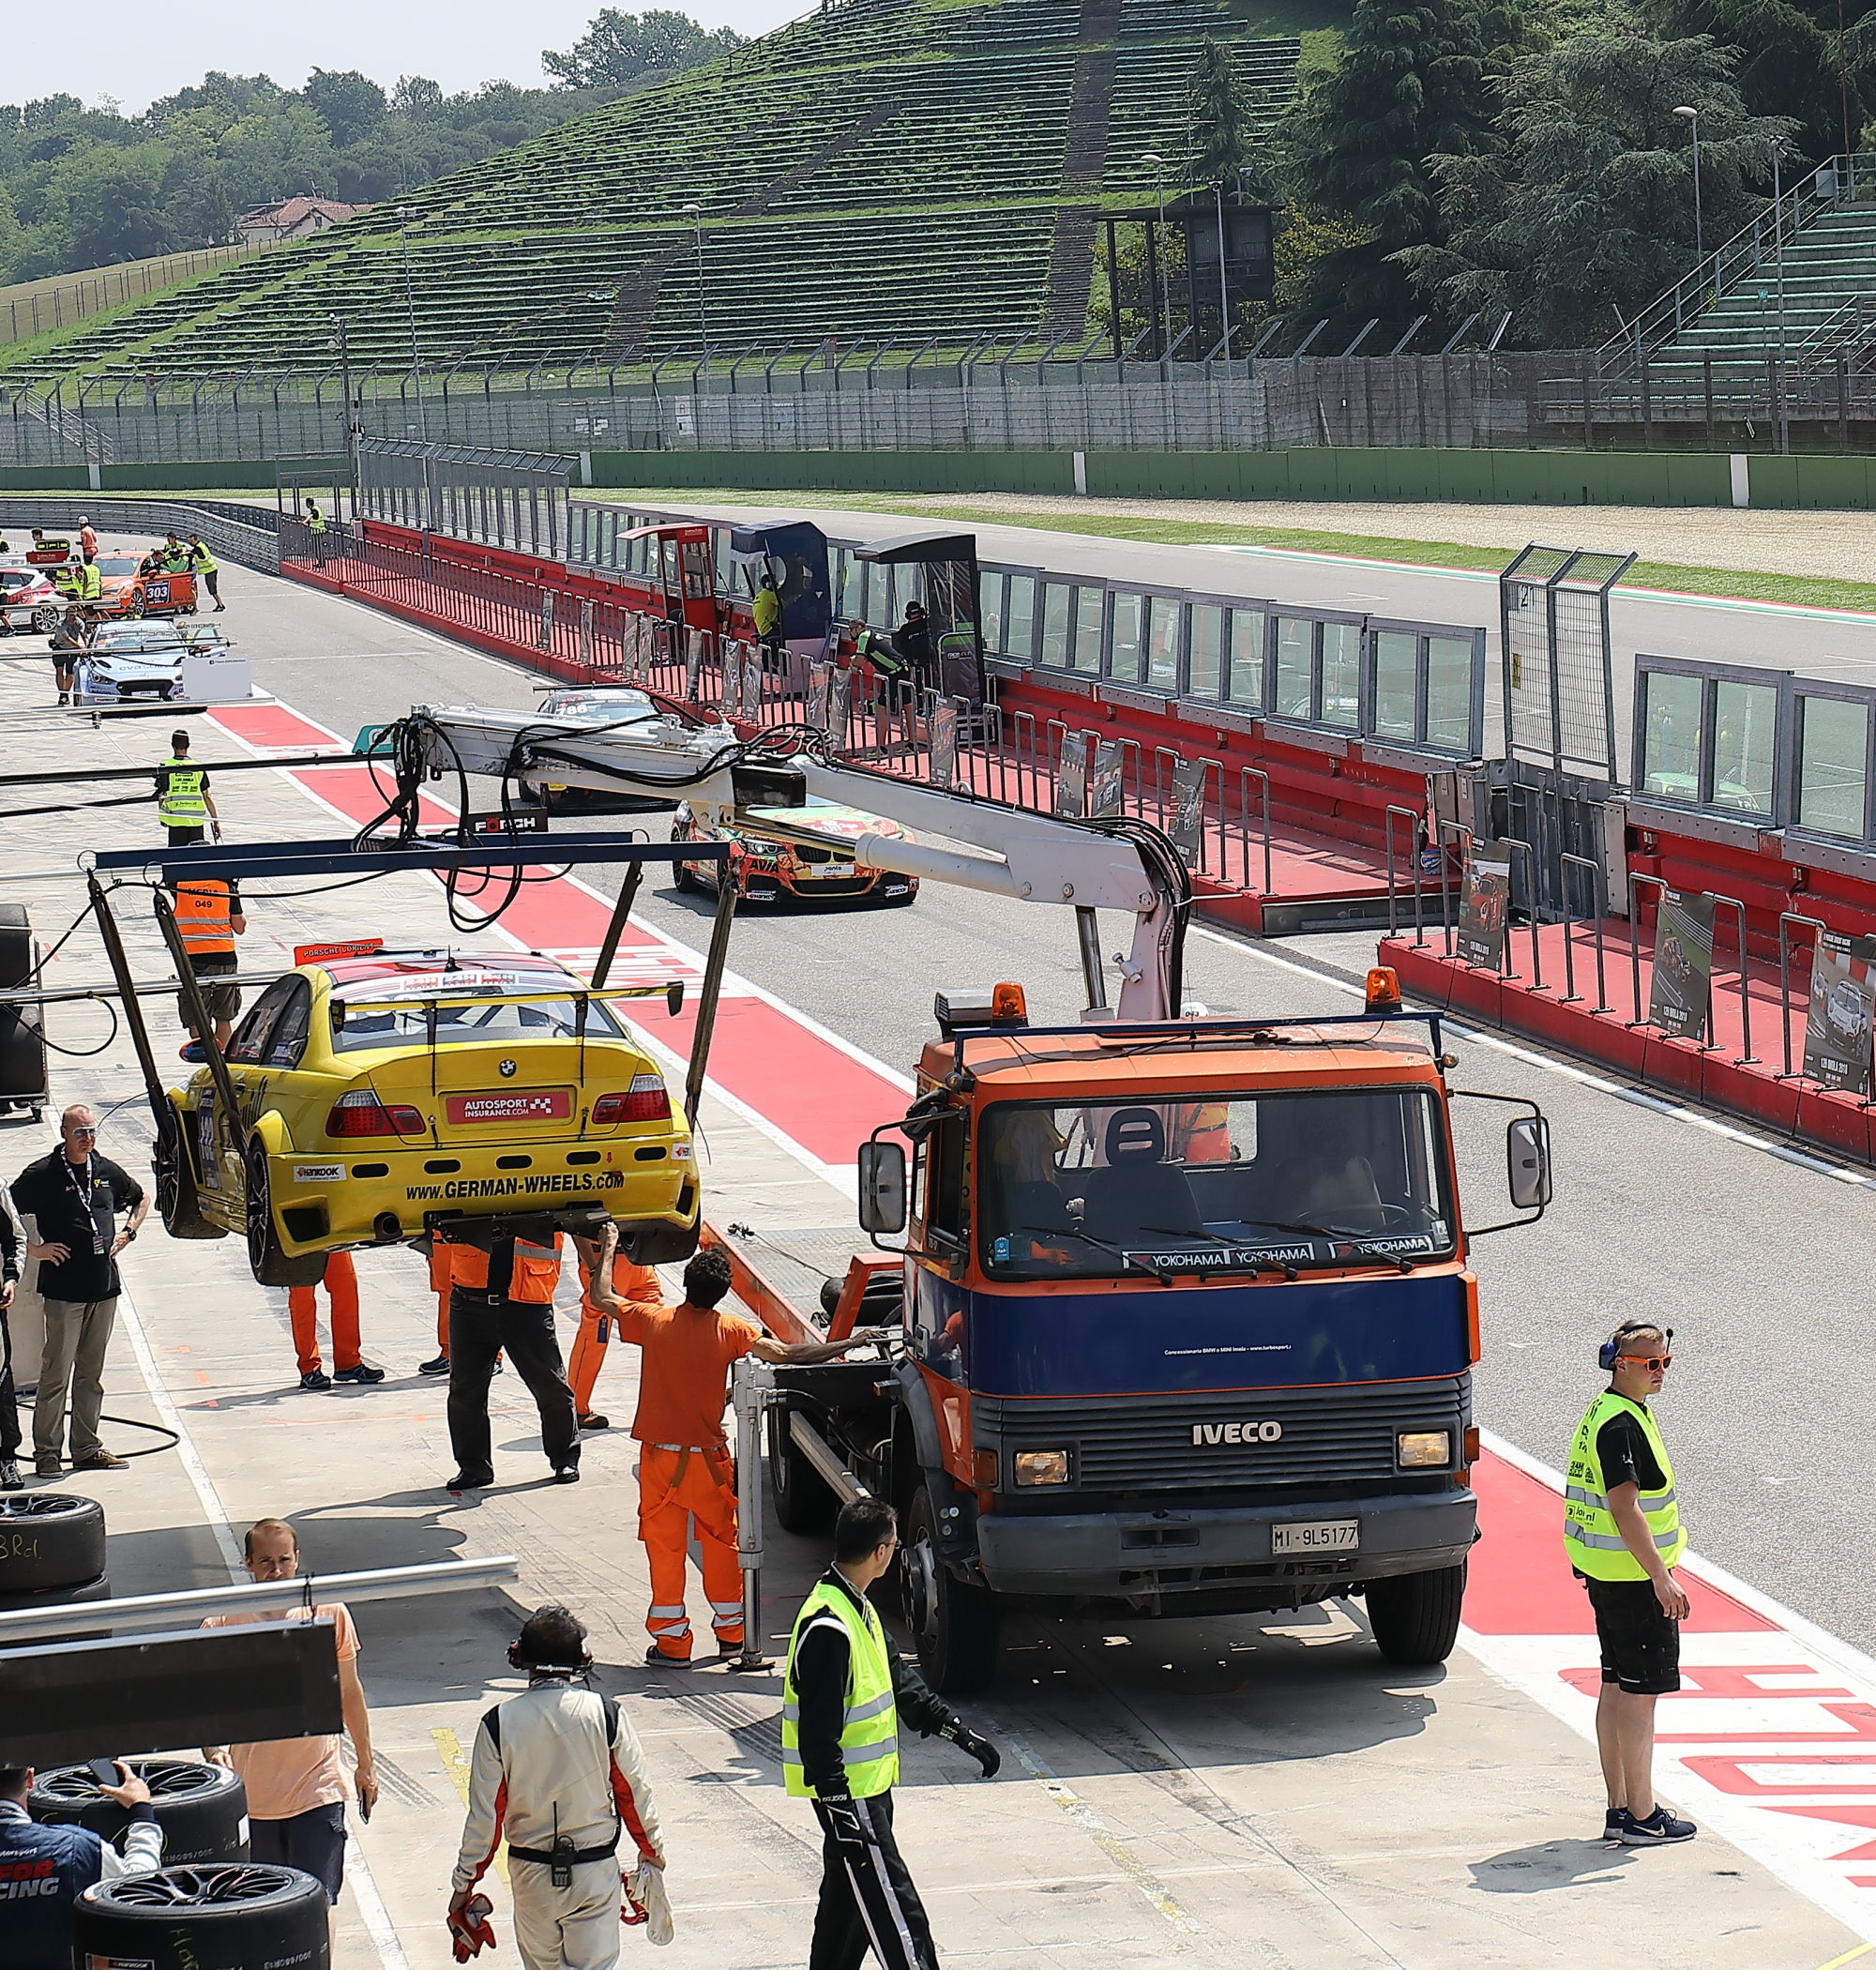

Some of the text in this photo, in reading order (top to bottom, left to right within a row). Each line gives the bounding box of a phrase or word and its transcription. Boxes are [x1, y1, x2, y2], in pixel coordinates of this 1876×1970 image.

[147, 586, 168, 599] 303
[750, 860, 779, 873] AVIA
[303, 947, 339, 957] PORSCHE
[464, 1099, 527, 1110] AUTOSPORT
[464, 1108, 529, 1118] INSURANCE.COM
[1358, 1237, 1427, 1253] YOKOHAMA
[1153, 1255, 1223, 1266] YOKOHAMA
[1236, 1248, 1309, 1264] YOKOHAMA
[1193, 1421, 1282, 1446] IVECO
